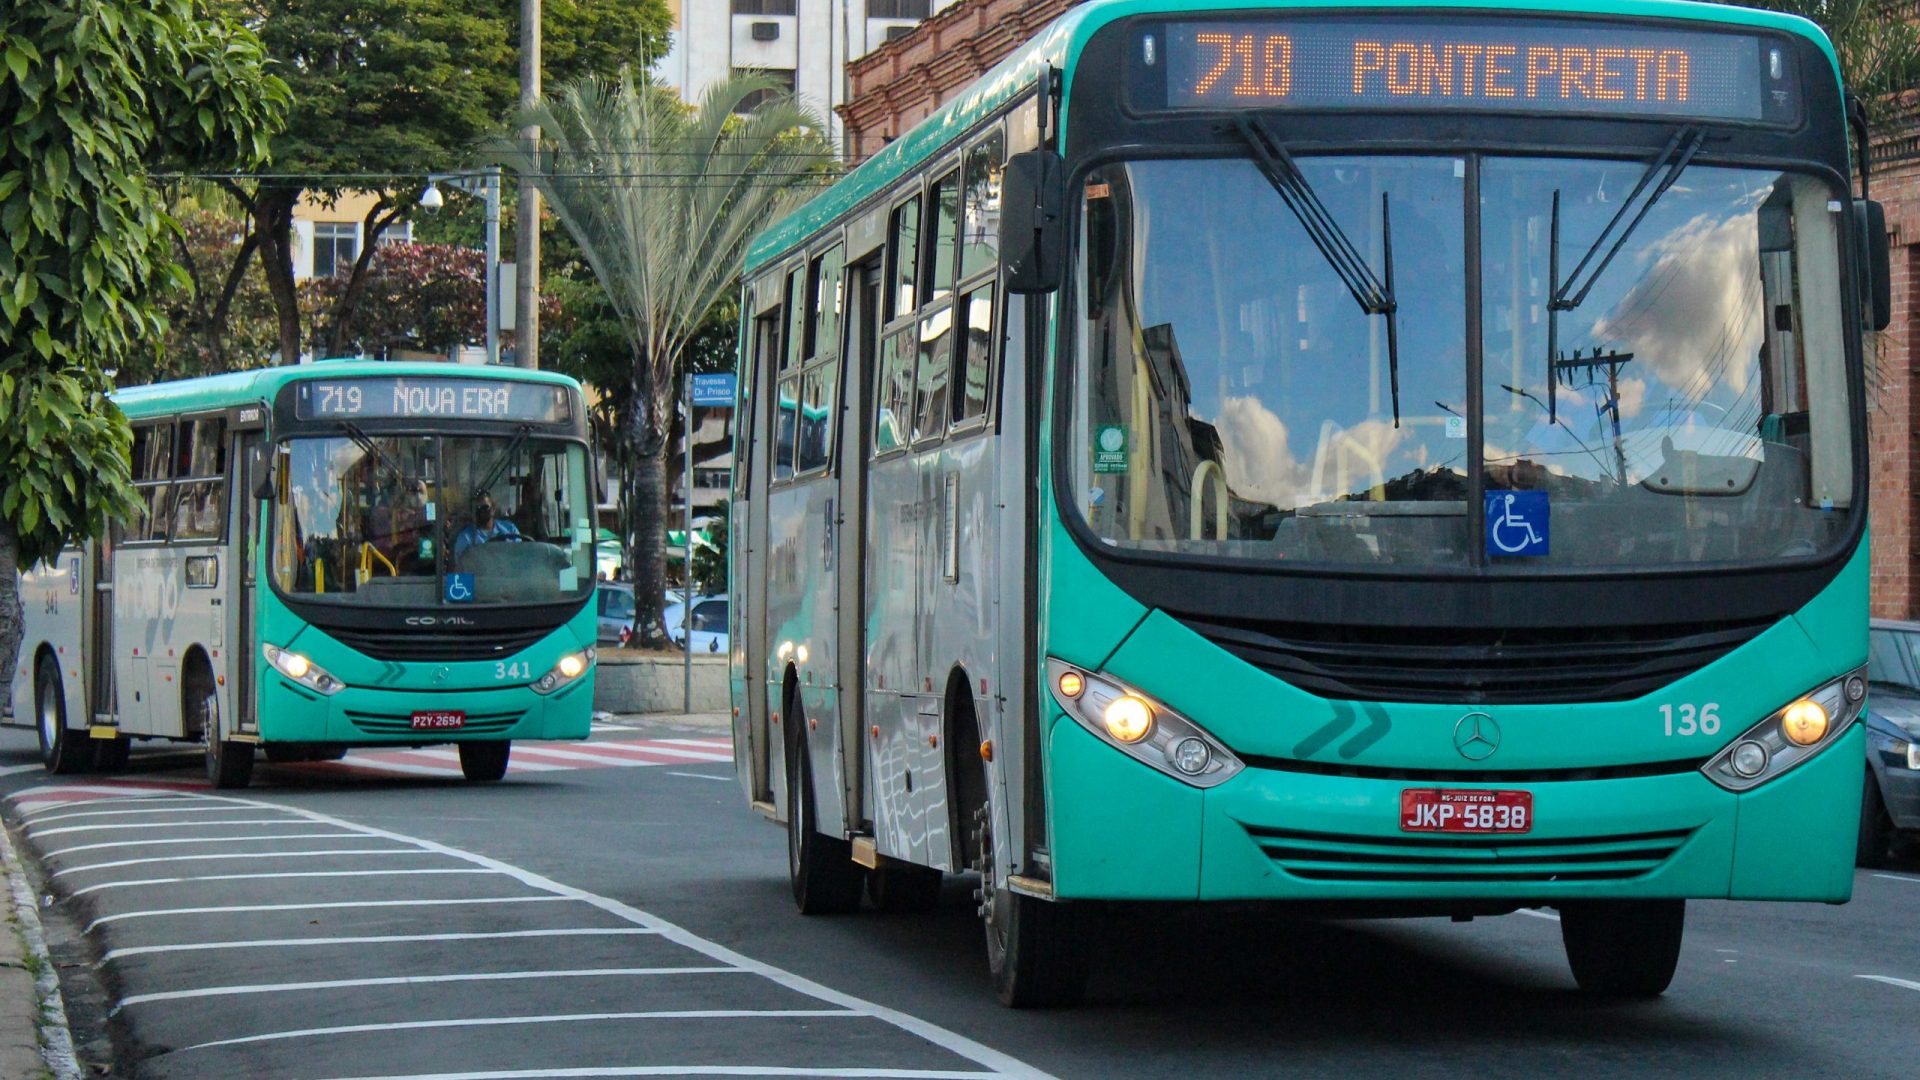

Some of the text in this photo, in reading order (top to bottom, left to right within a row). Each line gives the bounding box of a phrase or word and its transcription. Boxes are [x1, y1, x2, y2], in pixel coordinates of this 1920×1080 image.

[1196, 34, 1690, 102] 718 PONTE PRETA
[319, 386, 509, 414] 719 NOVA ERA
[405, 616, 474, 625] COMIL
[494, 661, 531, 680] 341
[1658, 702, 1721, 737] 136
